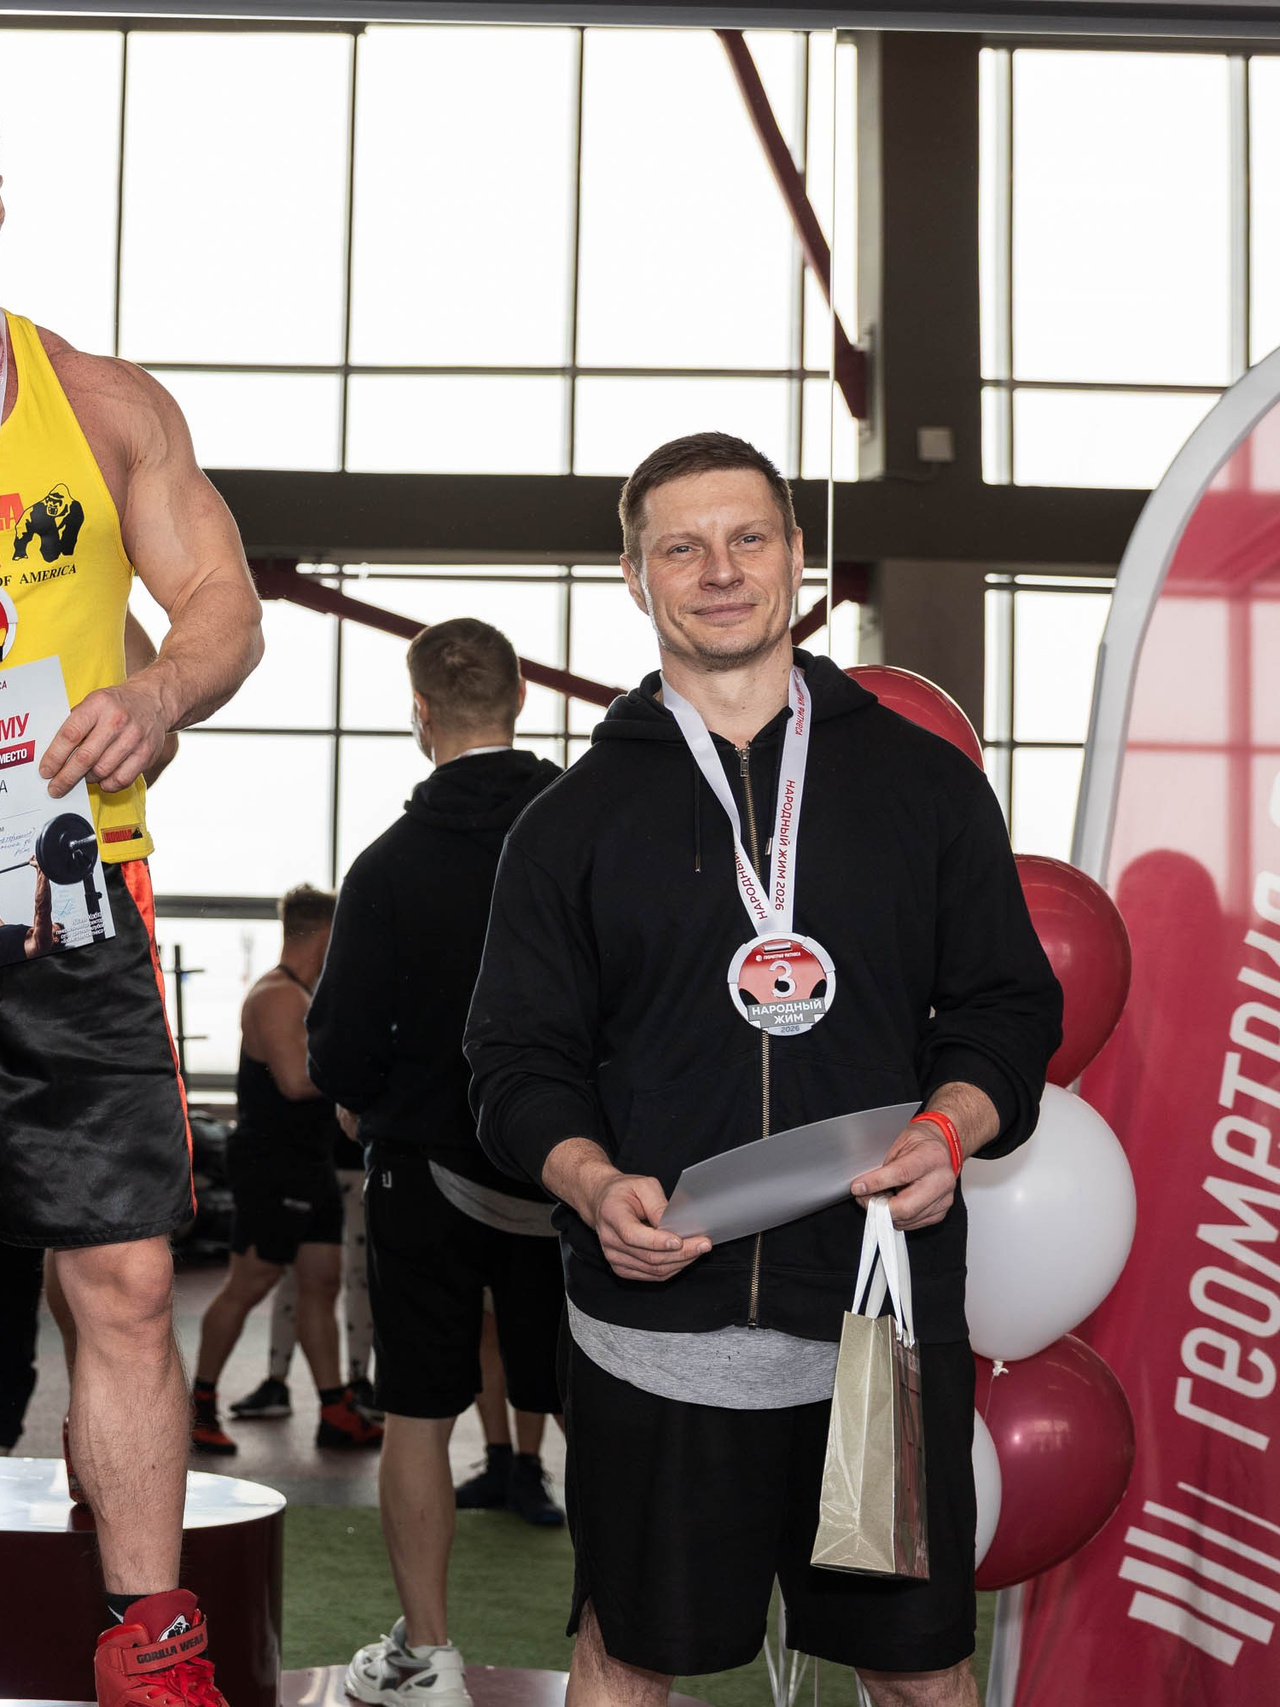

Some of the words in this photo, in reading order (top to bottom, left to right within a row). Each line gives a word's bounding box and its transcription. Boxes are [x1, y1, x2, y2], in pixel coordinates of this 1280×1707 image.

[19, 563, 77, 586] AMERICA
[779, 779, 796, 846] НАРОДНЫЙ
[777, 849, 788, 879] ЖИМ
[775, 882, 786, 911] 2026
[768, 960, 797, 998] 3
[752, 999, 822, 1016] НАРОДНЫЙ
[774, 1013, 804, 1025] ЖИМ
[136, 1644, 178, 1665] GORILLA
[175, 1632, 205, 1657] WEAR
